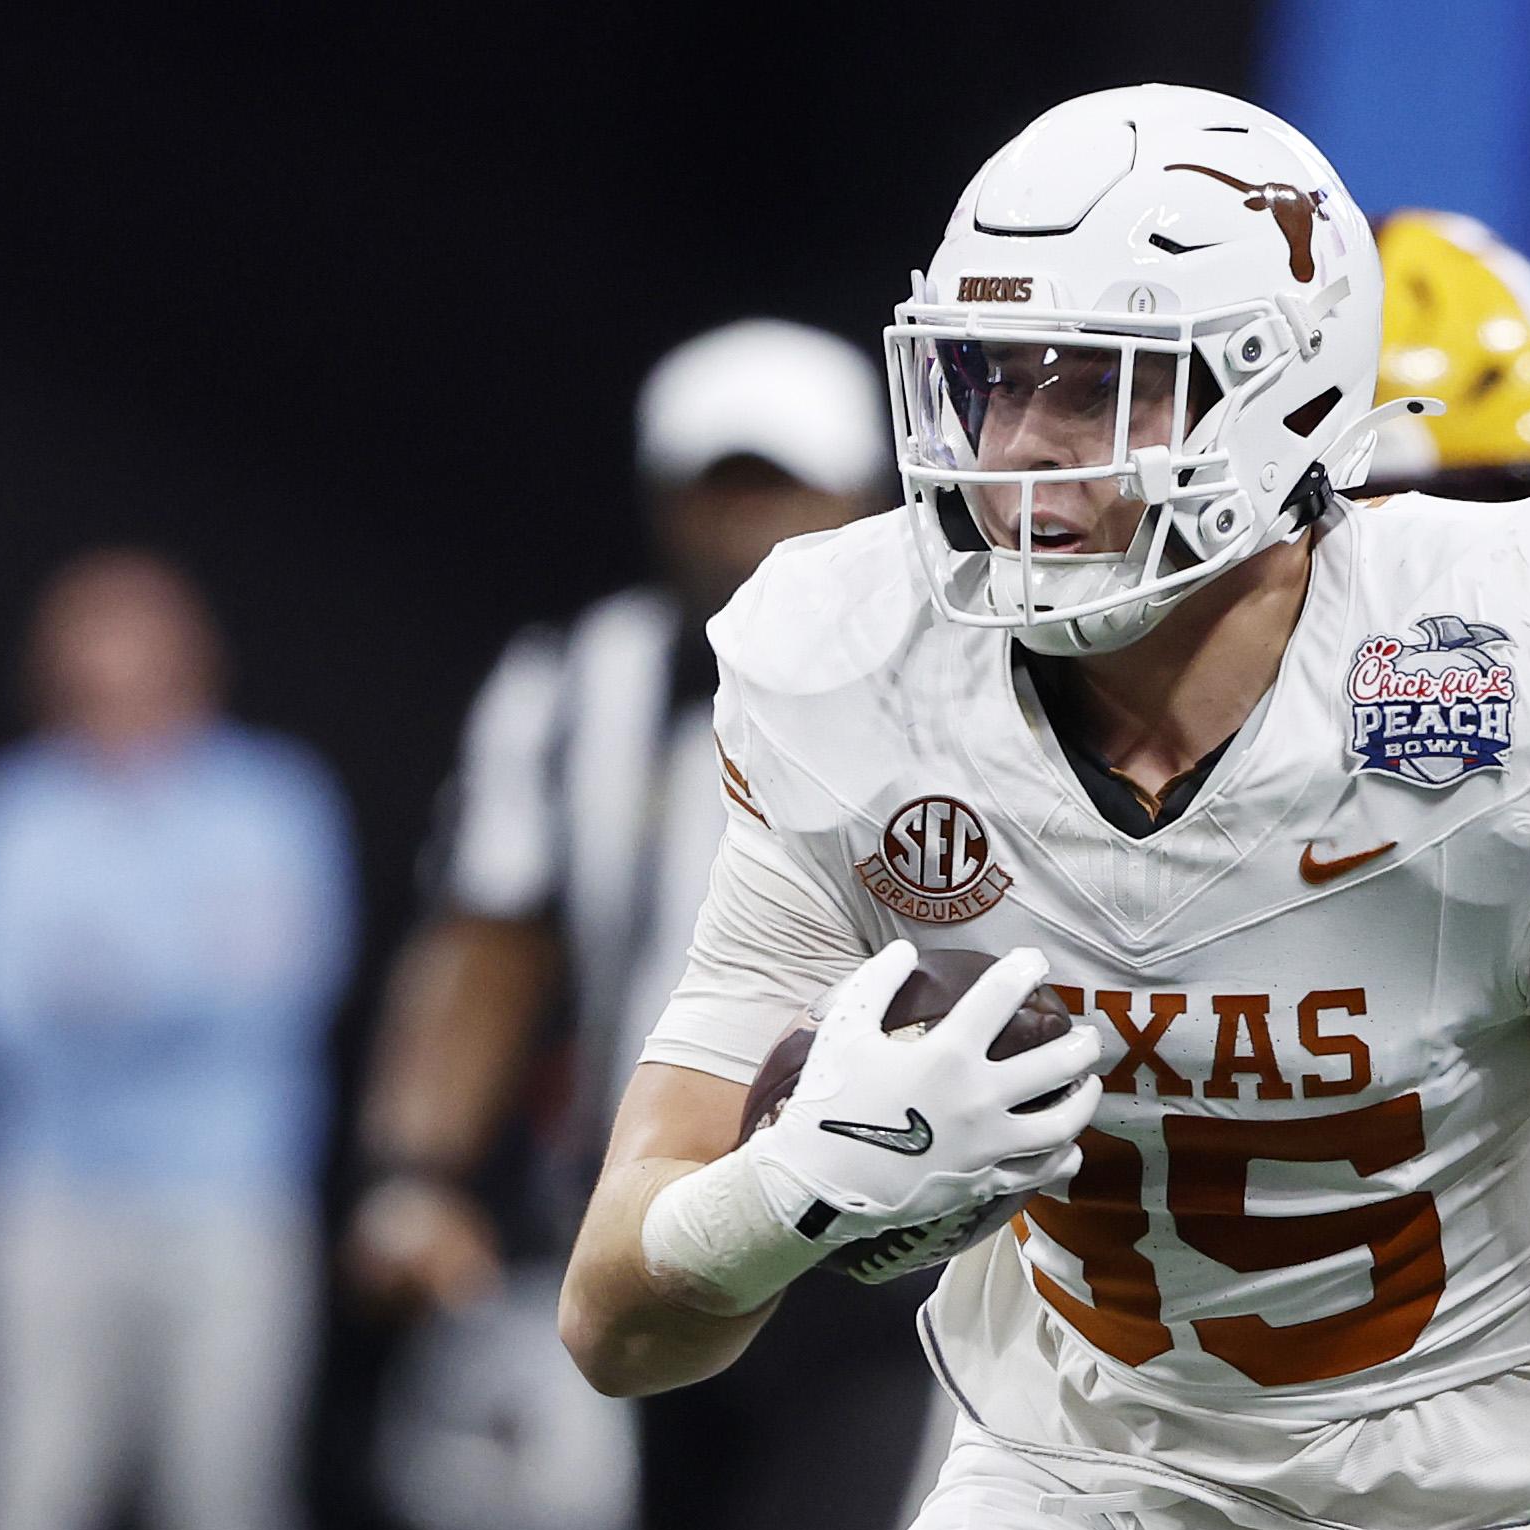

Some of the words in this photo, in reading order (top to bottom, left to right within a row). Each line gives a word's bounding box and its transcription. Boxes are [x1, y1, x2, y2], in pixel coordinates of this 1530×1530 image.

[957, 277, 1033, 302] HORNS
[1354, 703, 1510, 750] PEACH
[1385, 739, 1479, 757] BOWL
[891, 801, 982, 889] SEC
[873, 878, 991, 920] GRADUATE
[1047, 983, 1373, 1101] XAS
